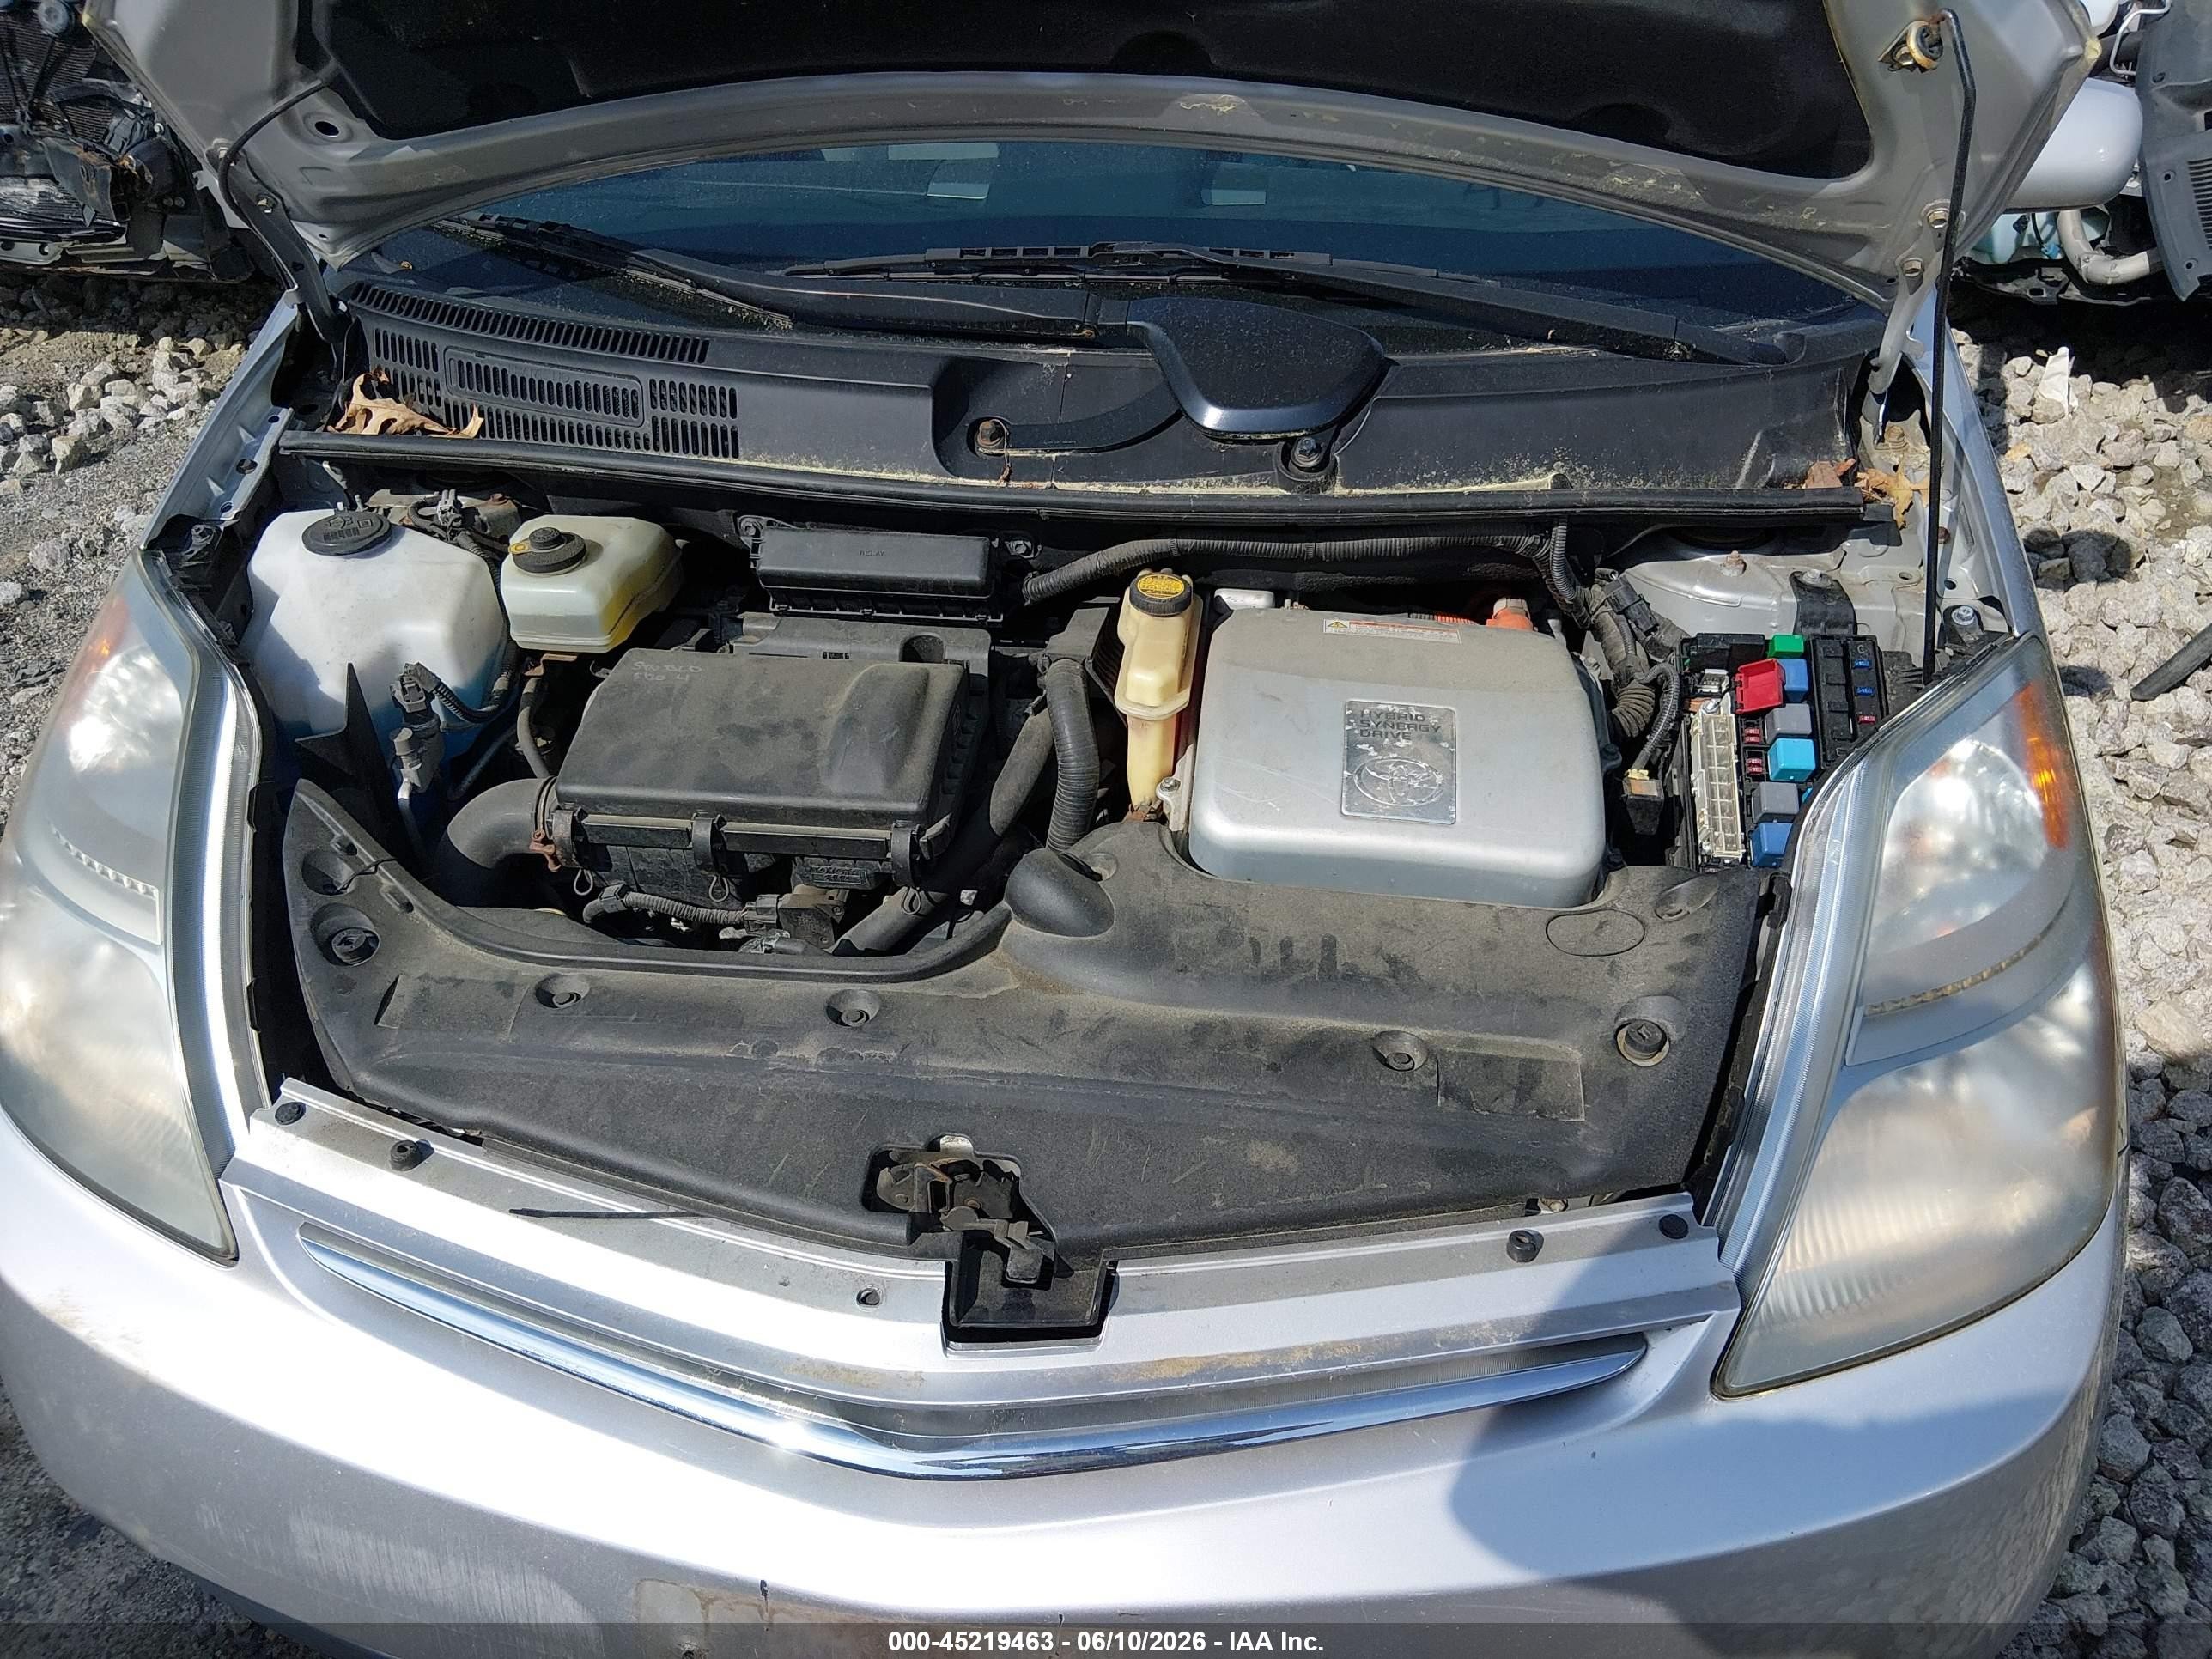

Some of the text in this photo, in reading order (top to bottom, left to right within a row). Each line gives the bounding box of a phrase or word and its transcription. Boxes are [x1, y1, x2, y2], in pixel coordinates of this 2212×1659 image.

[1361, 710, 1425, 721] HYBRID
[1359, 720, 1443, 732] SYNERGY
[1360, 729, 1412, 740] DRIVE
